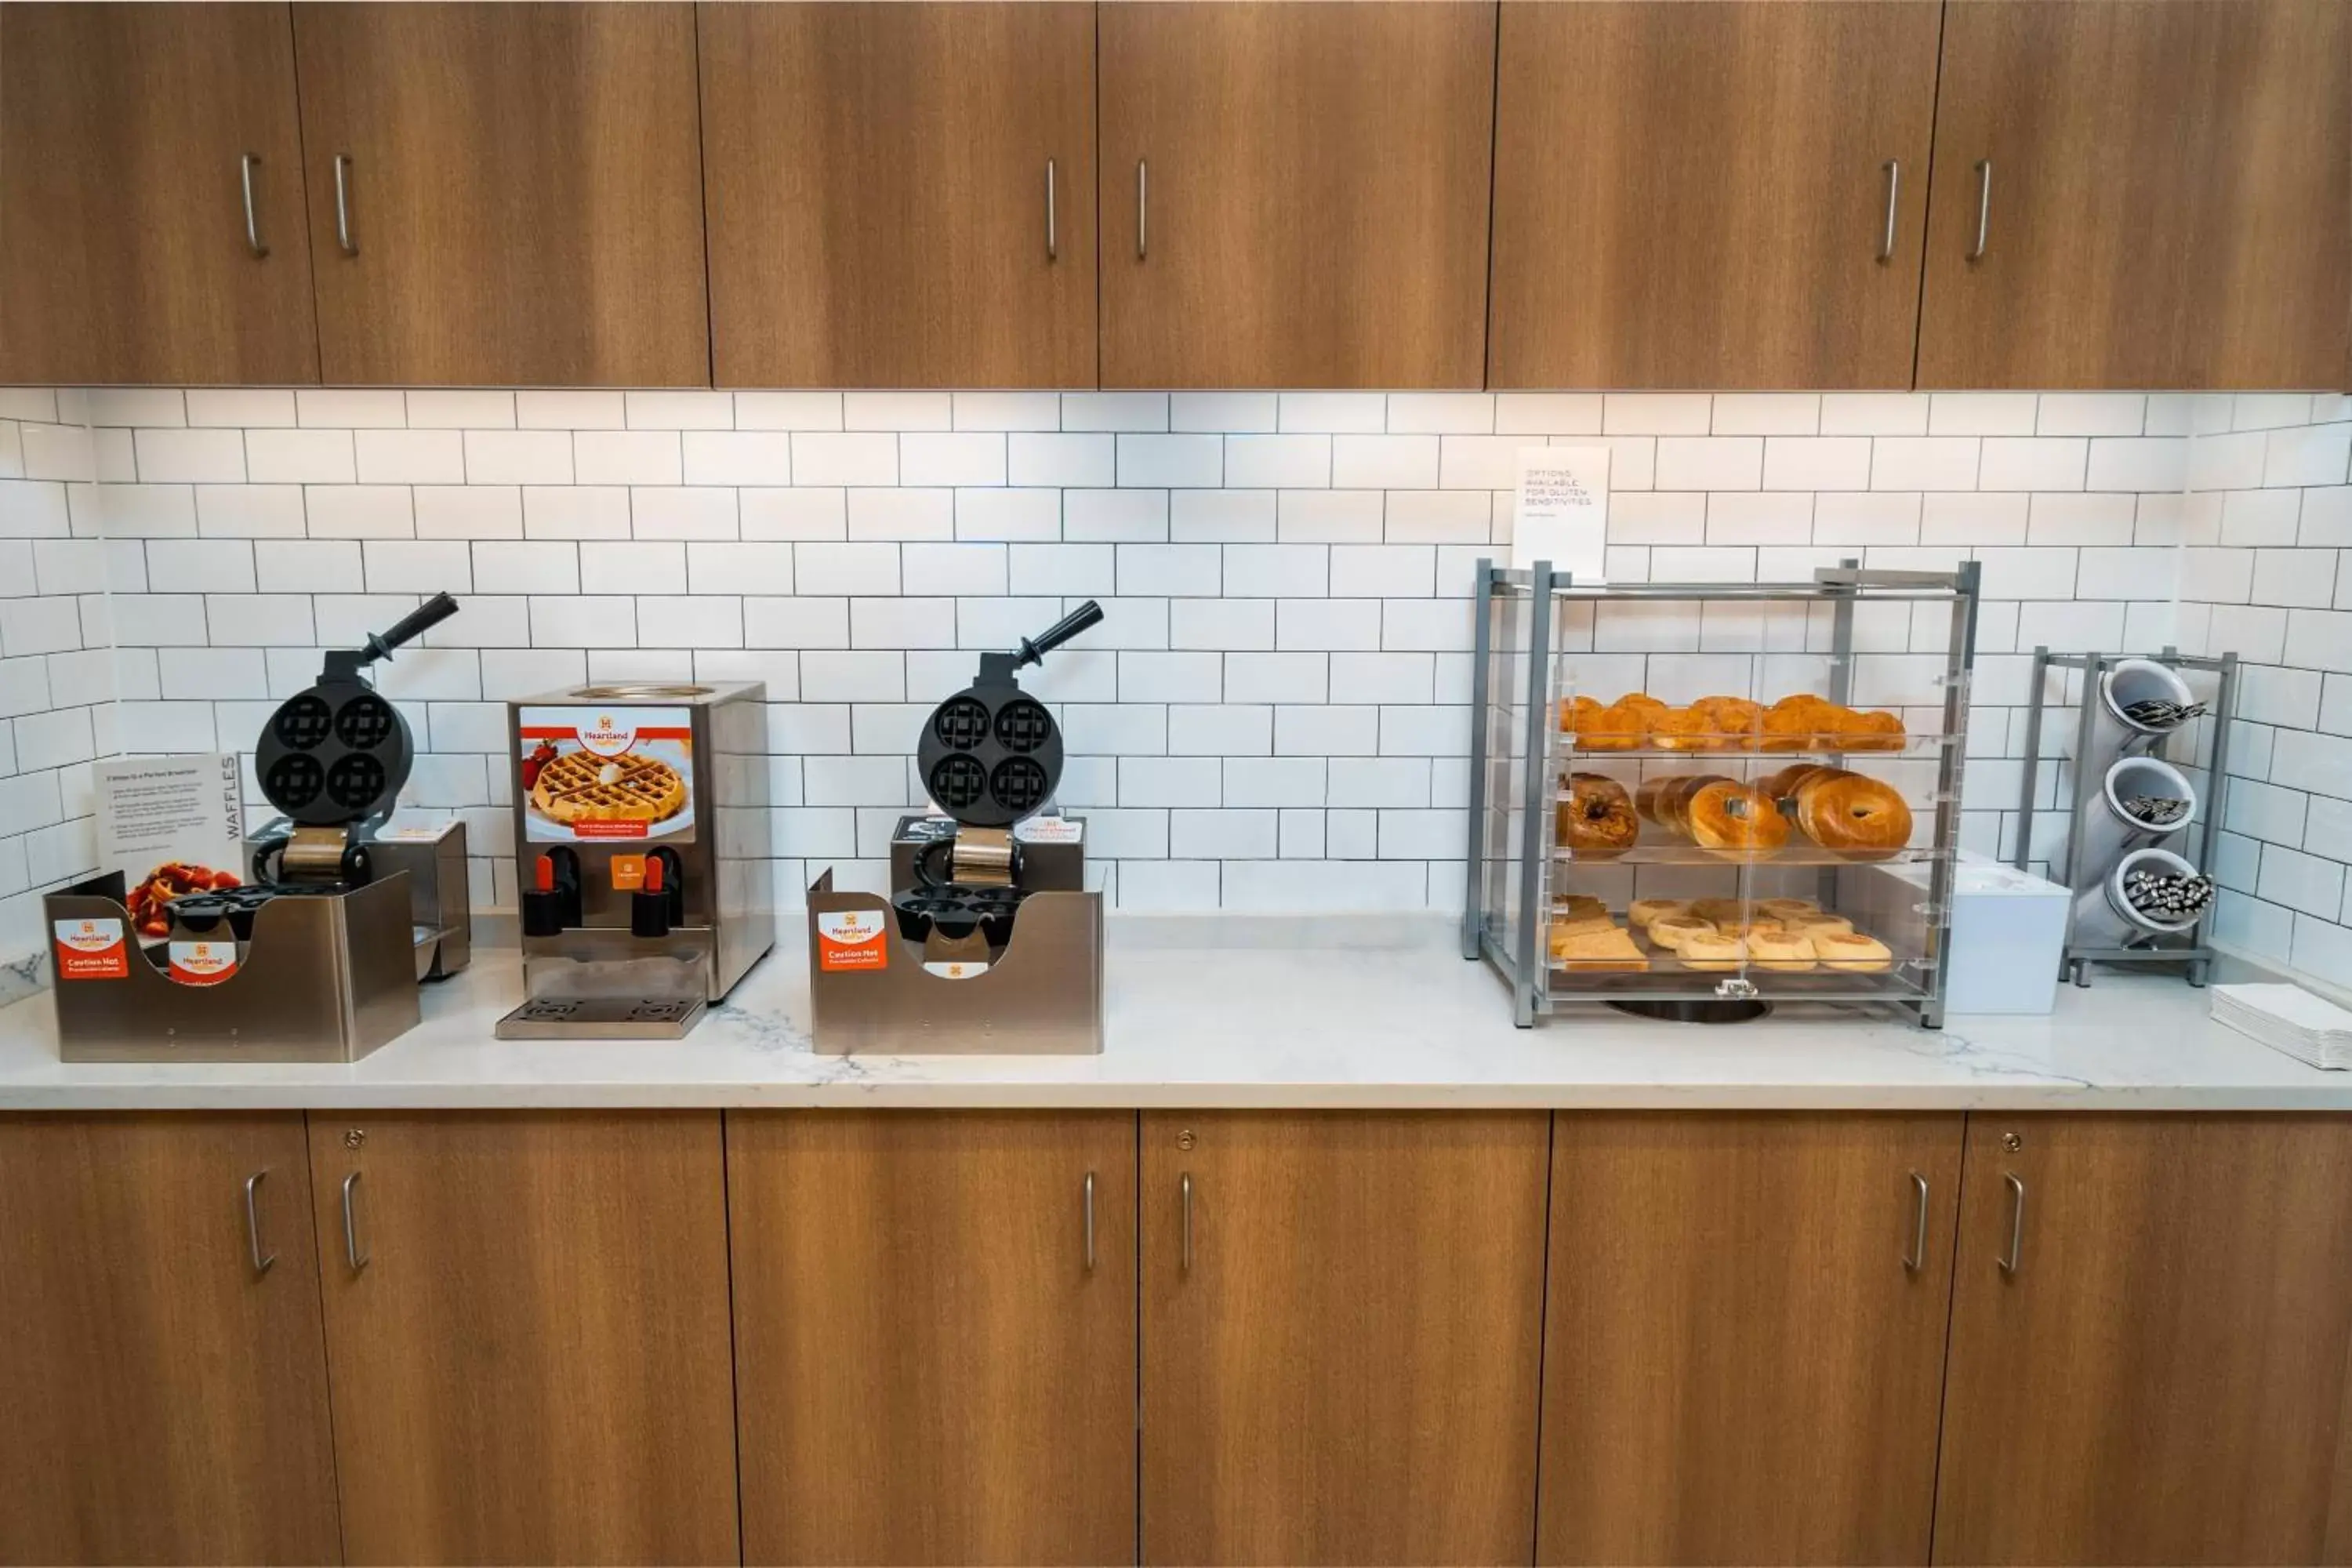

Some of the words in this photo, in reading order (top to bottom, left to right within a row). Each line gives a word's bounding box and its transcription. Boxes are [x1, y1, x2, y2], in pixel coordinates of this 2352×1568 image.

[222, 757, 239, 840] WAFFLES
[832, 926, 872, 935] Heartland
[828, 950, 862, 959] Caution
[67, 959, 102, 967] Caution
[102, 957, 120, 966] Hot
[183, 956, 223, 965] Heartland
